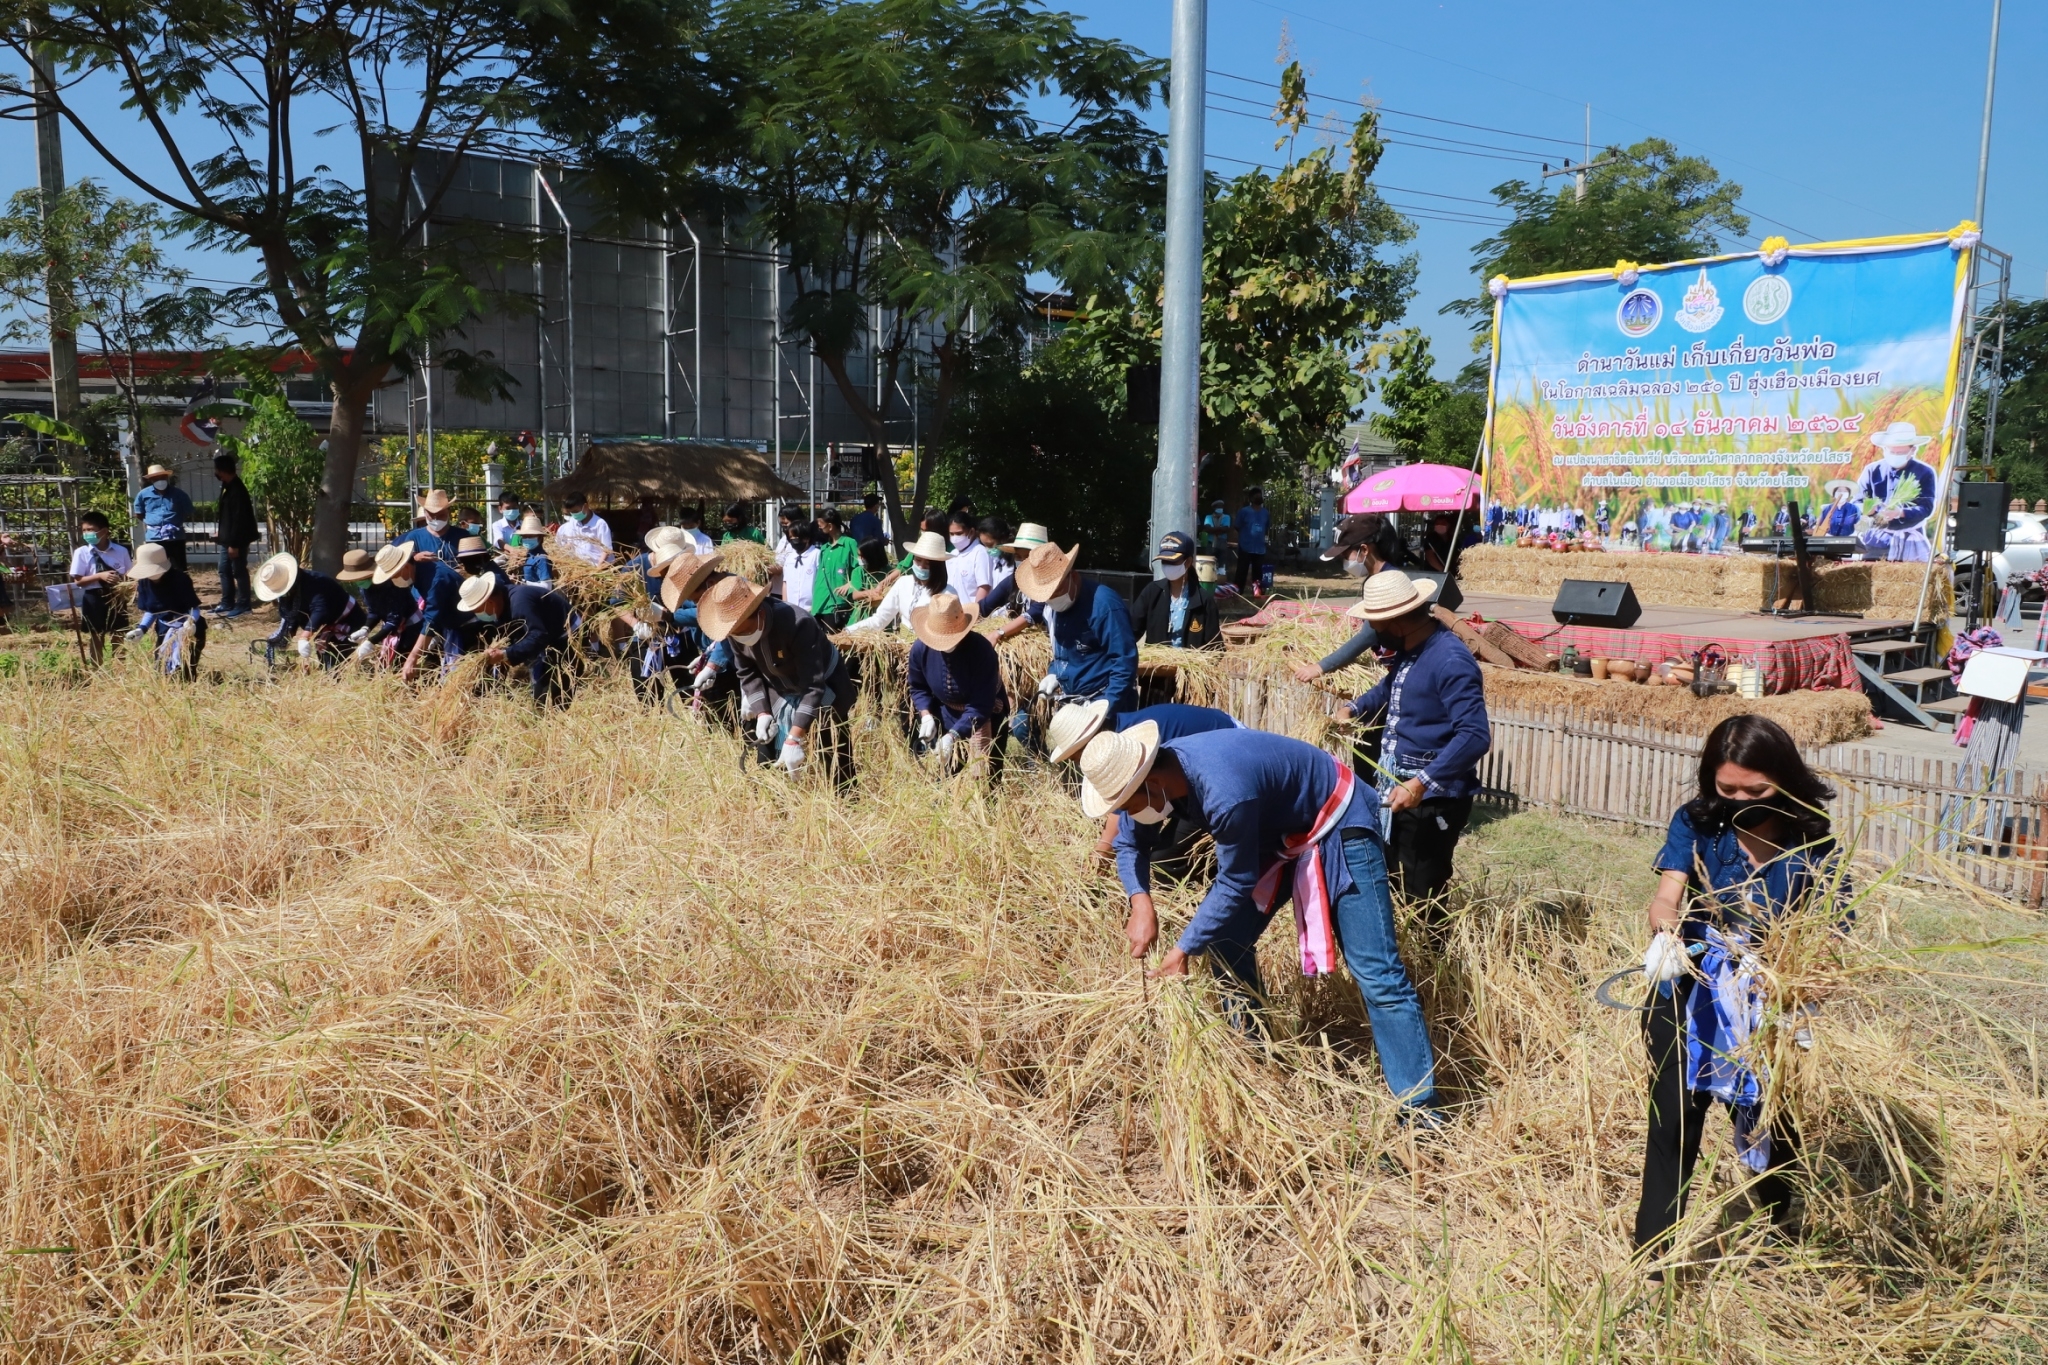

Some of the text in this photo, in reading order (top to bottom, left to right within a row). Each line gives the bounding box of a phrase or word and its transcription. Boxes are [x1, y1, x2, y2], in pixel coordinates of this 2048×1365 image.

[1577, 335, 1836, 373] ดำนาวันแม่ เก็บเกี่ยววันพ่อ
[1542, 367, 1880, 399] ในโอกาสเฉลิมฉลอง ๒๕๐ ปี ฮุ่งเฮืองเมืองยศ
[1553, 408, 1863, 437] วันอังคารที่ ๑๔ ธันวาคม ๒๕๖๔
[1553, 447, 1851, 465] ณ แปลงนาสาธิตอินทรีย์ บริเวณหน้าศาลากลางจังหวัดยโสธร
[1583, 472, 1808, 486] ตำบลในเมือง อำเภอเมืองยโสธร จังหวัดยโสธร
